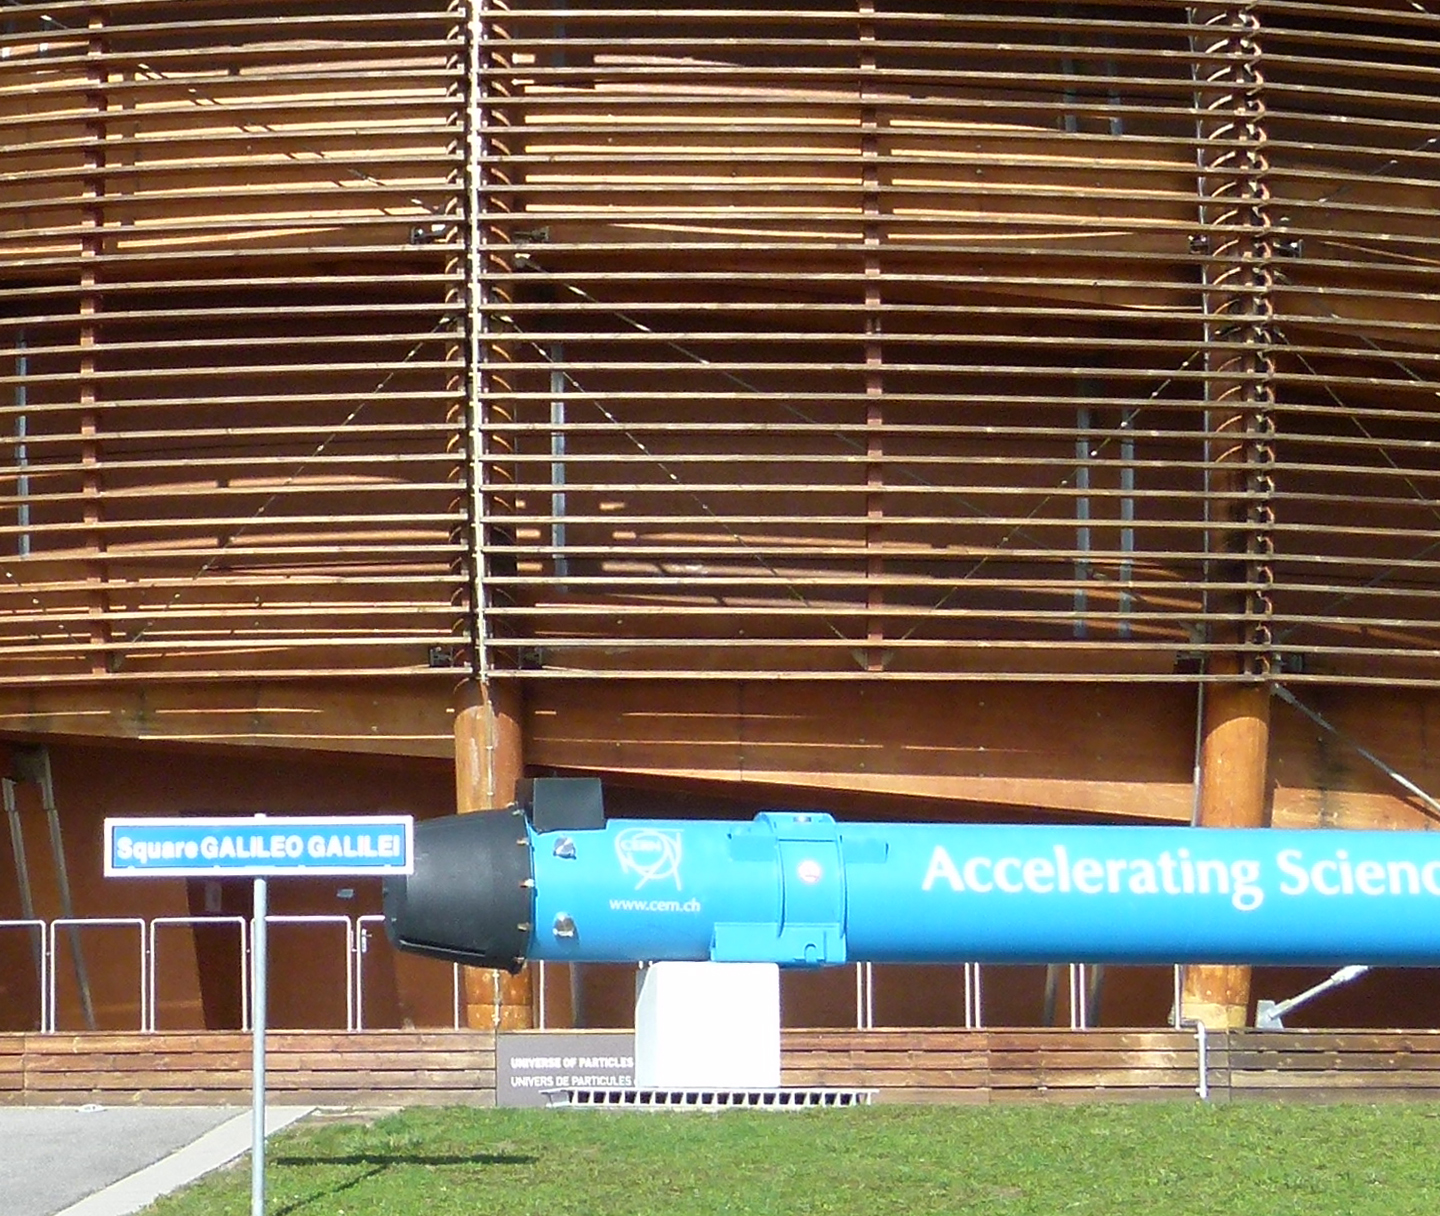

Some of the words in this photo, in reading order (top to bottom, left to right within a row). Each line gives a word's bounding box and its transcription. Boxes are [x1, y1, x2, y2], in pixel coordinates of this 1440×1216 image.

[117, 836, 198, 863] Square
[200, 835, 303, 859] GALILEO
[307, 834, 400, 858] GALILEI
[921, 845, 1264, 911] Accelerating
[609, 897, 701, 913] www.cern.ch
[510, 1057, 562, 1069] UNIVERSE
[563, 1057, 577, 1069] OF
[579, 1056, 634, 1068] PARTICLES
[510, 1076, 554, 1087] UNIVERS
[555, 1076, 570, 1087] DE
[571, 1075, 632, 1086] PARTICULES
